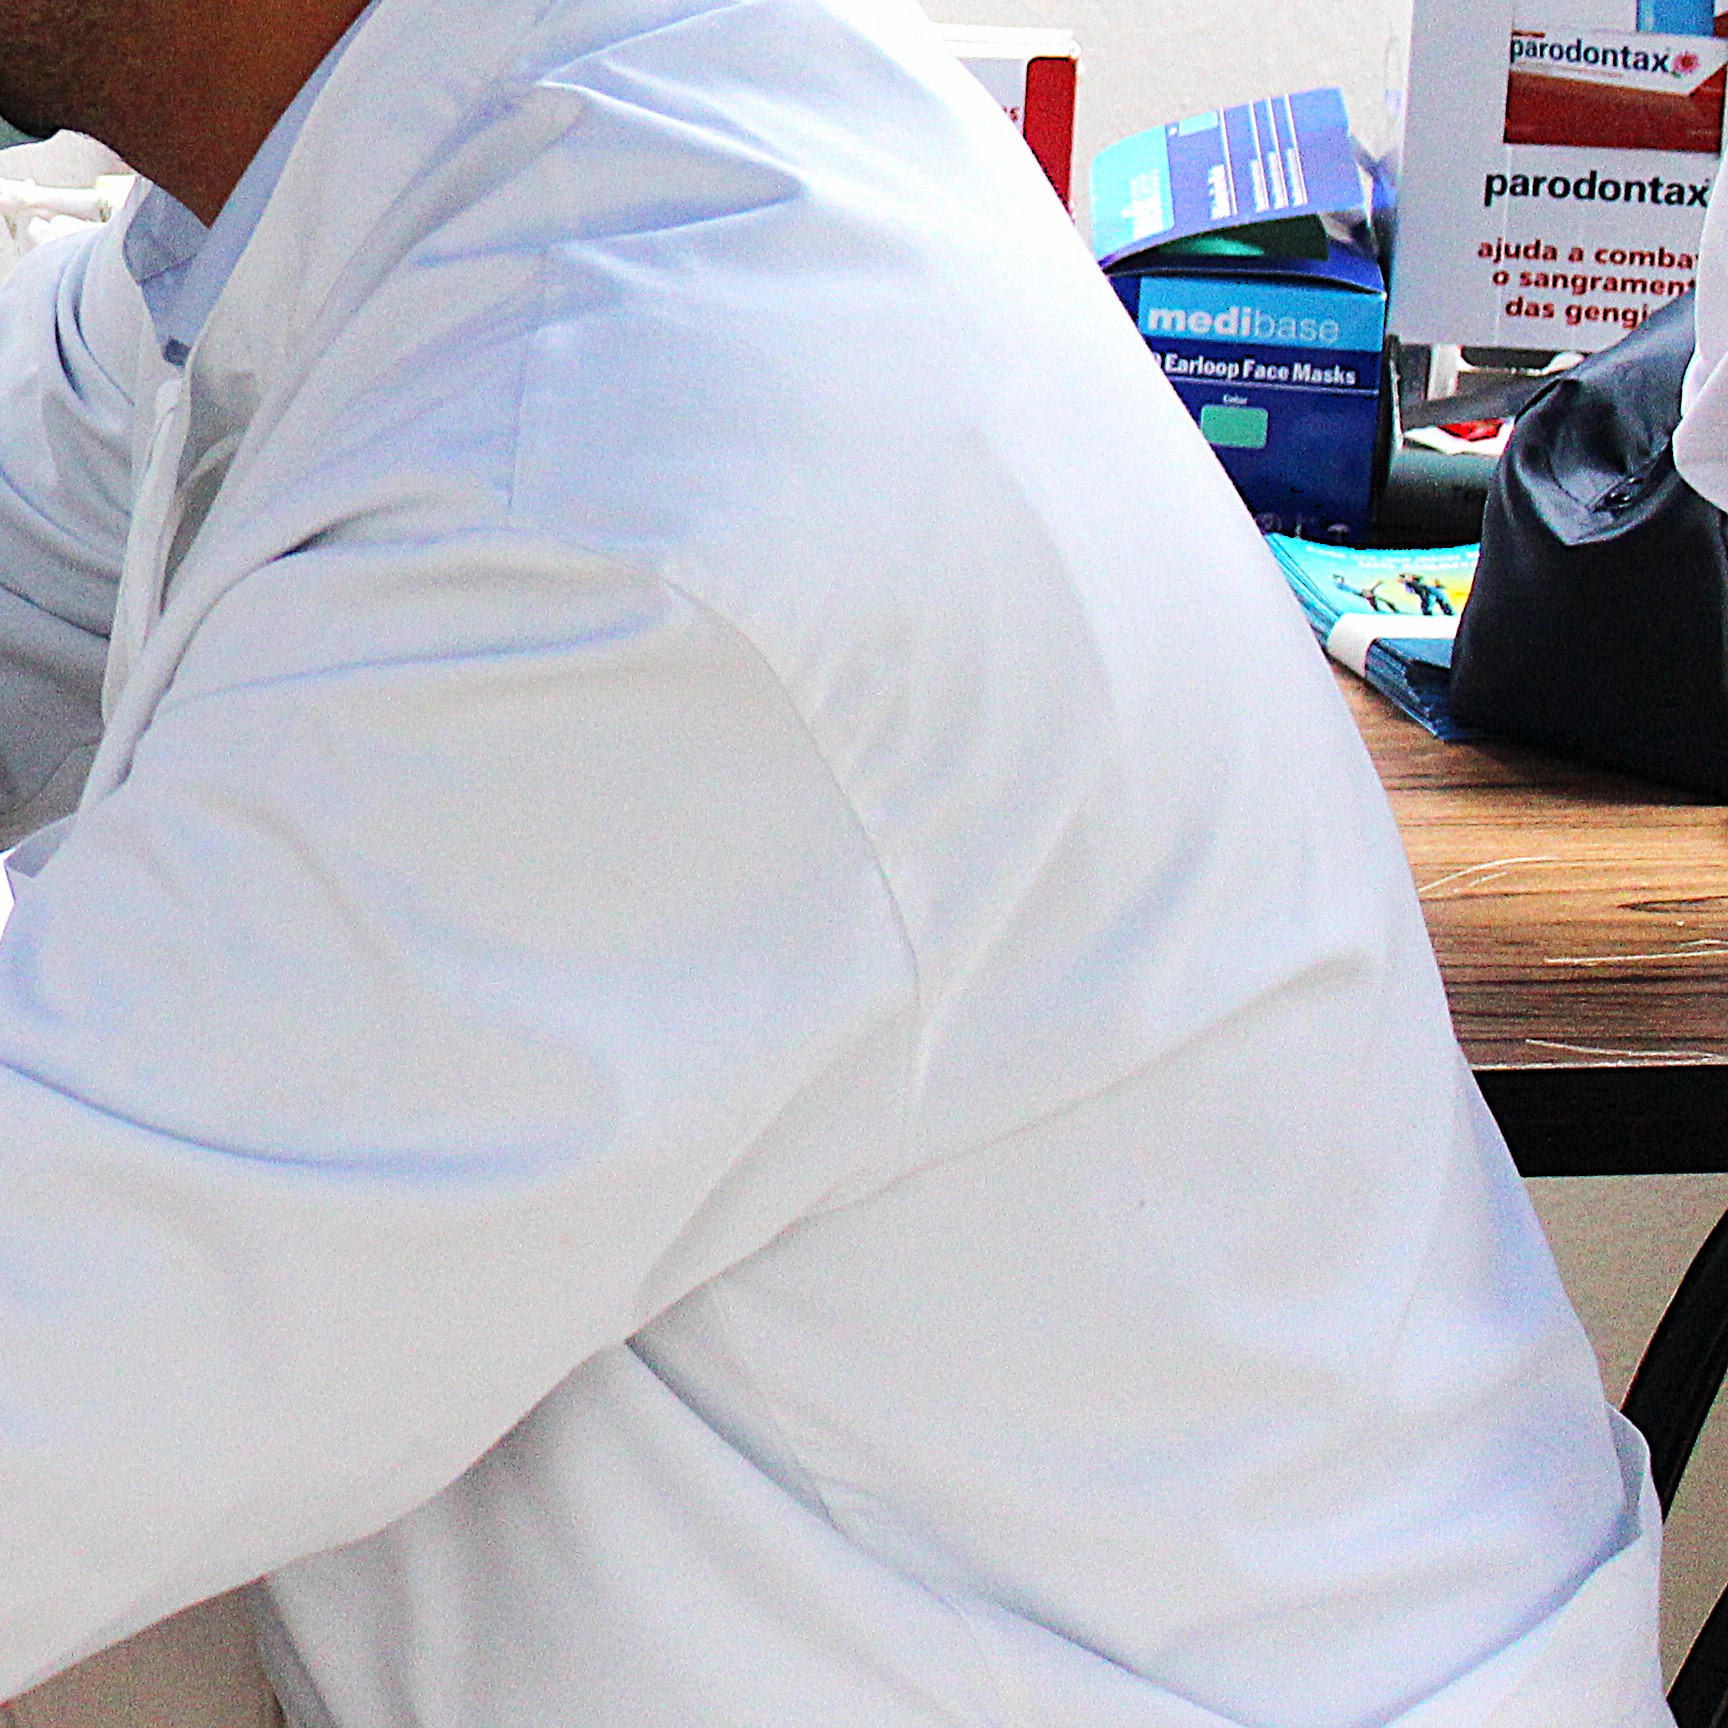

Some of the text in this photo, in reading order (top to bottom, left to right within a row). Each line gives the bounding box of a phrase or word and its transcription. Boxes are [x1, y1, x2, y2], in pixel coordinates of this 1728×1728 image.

[1511, 38, 1670, 73] parodontax
[1484, 170, 1710, 207] parodontax
[1478, 237, 1698, 269] ajuda a comba
[1493, 270, 1510, 286] o
[1505, 297, 1555, 318] das
[1147, 306, 1339, 344] medibase
[1165, 352, 1239, 380] Earloop
[1243, 358, 1289, 382] Face
[1293, 362, 1356, 386] Masks
